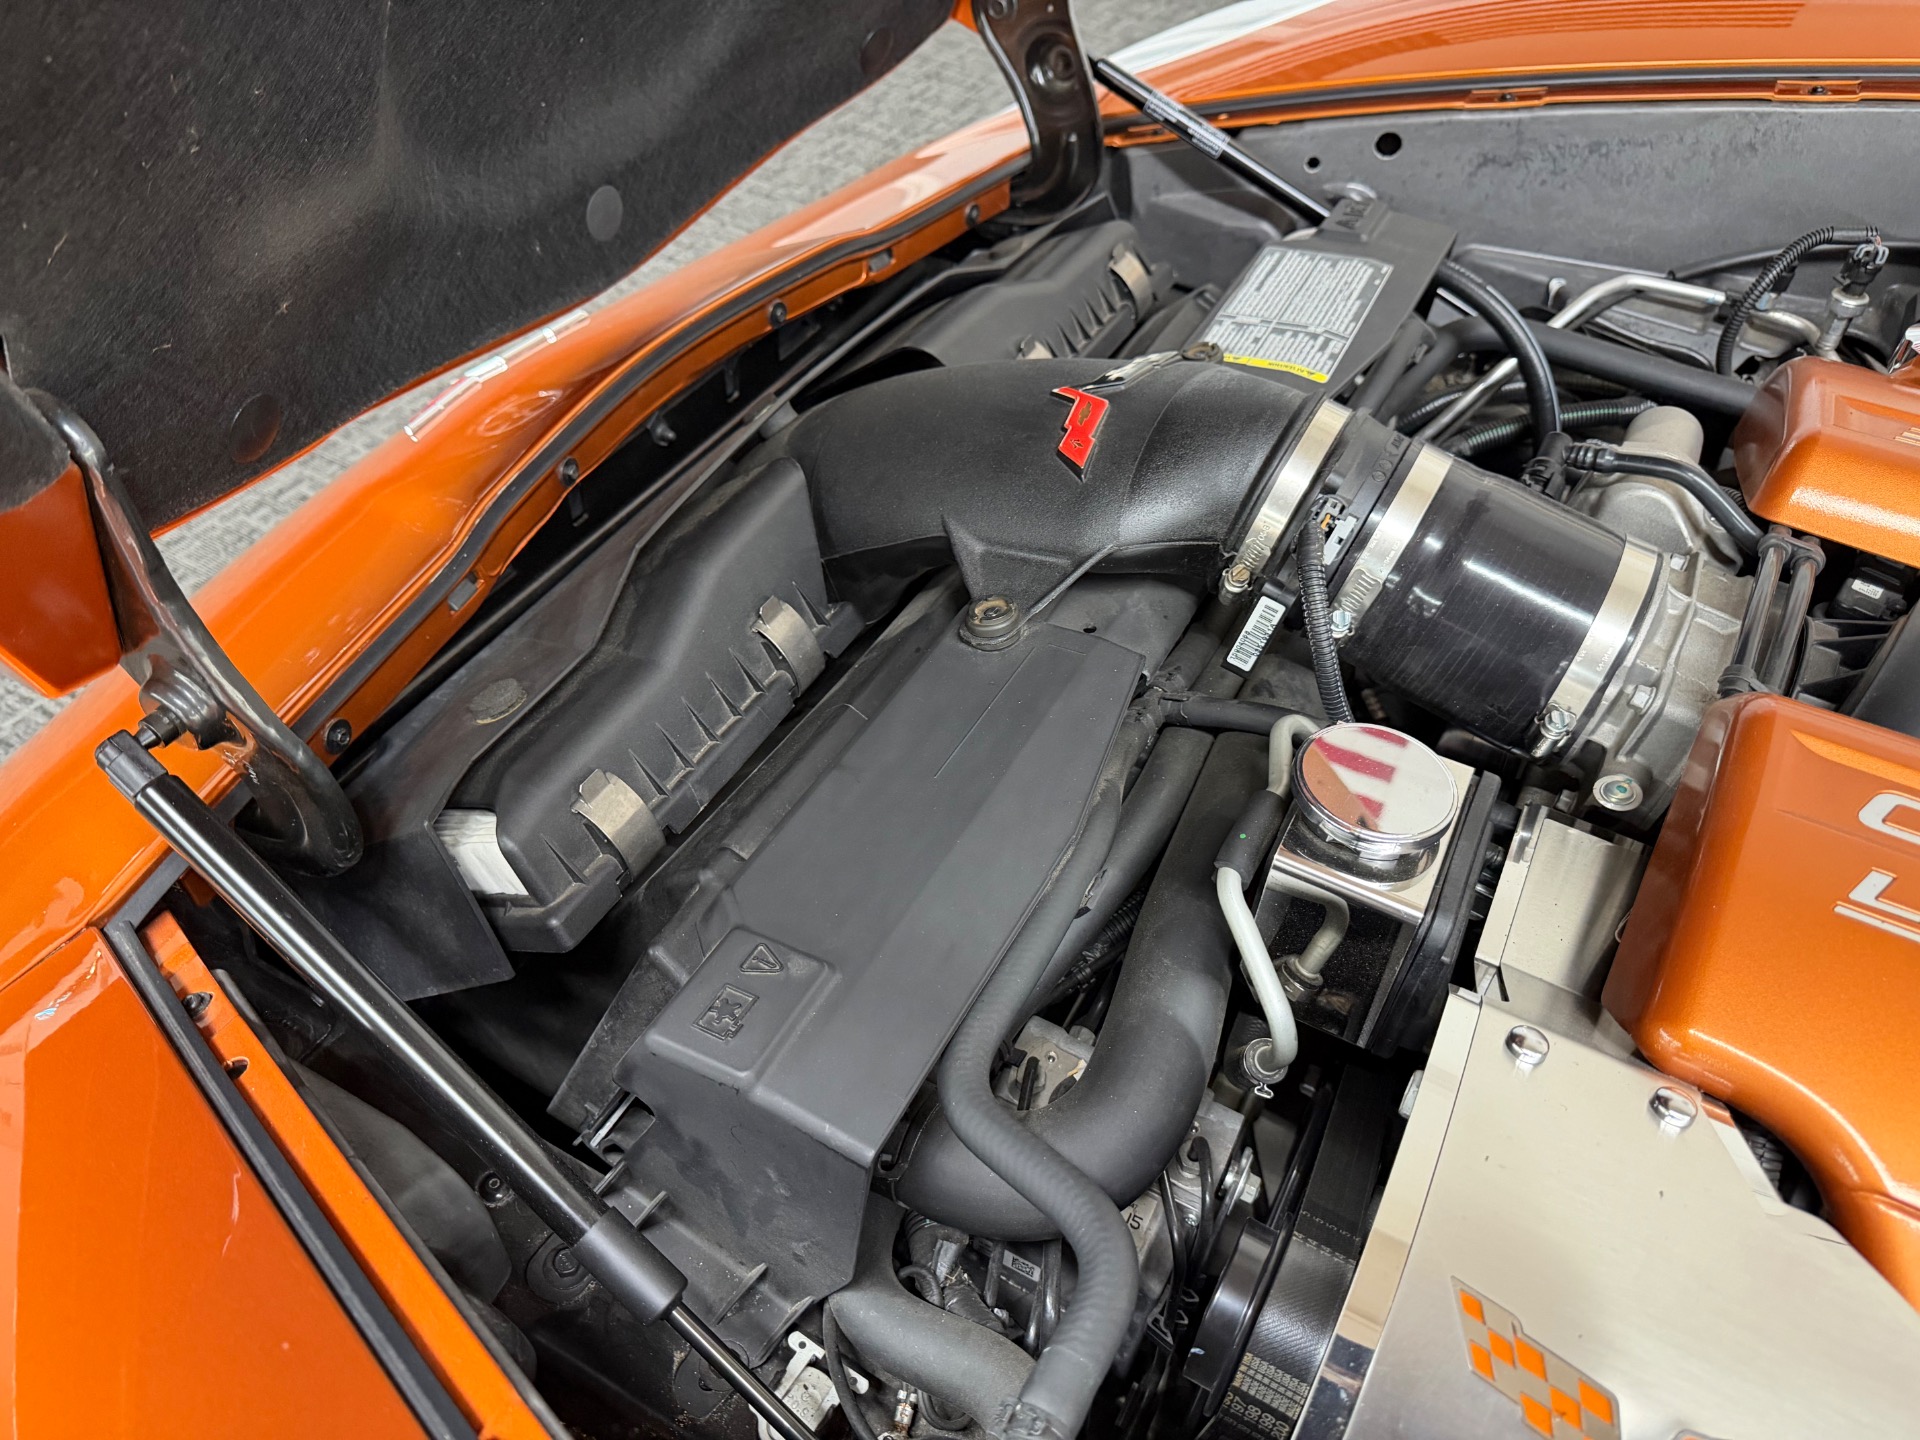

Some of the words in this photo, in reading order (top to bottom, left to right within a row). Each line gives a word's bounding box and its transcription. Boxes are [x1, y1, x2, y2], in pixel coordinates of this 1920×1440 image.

[1230, 1395, 1247, 1416] 197
[1244, 1404, 1261, 1425] 198
[1258, 1412, 1276, 1432] 199
[1271, 1420, 1290, 1440] 200
